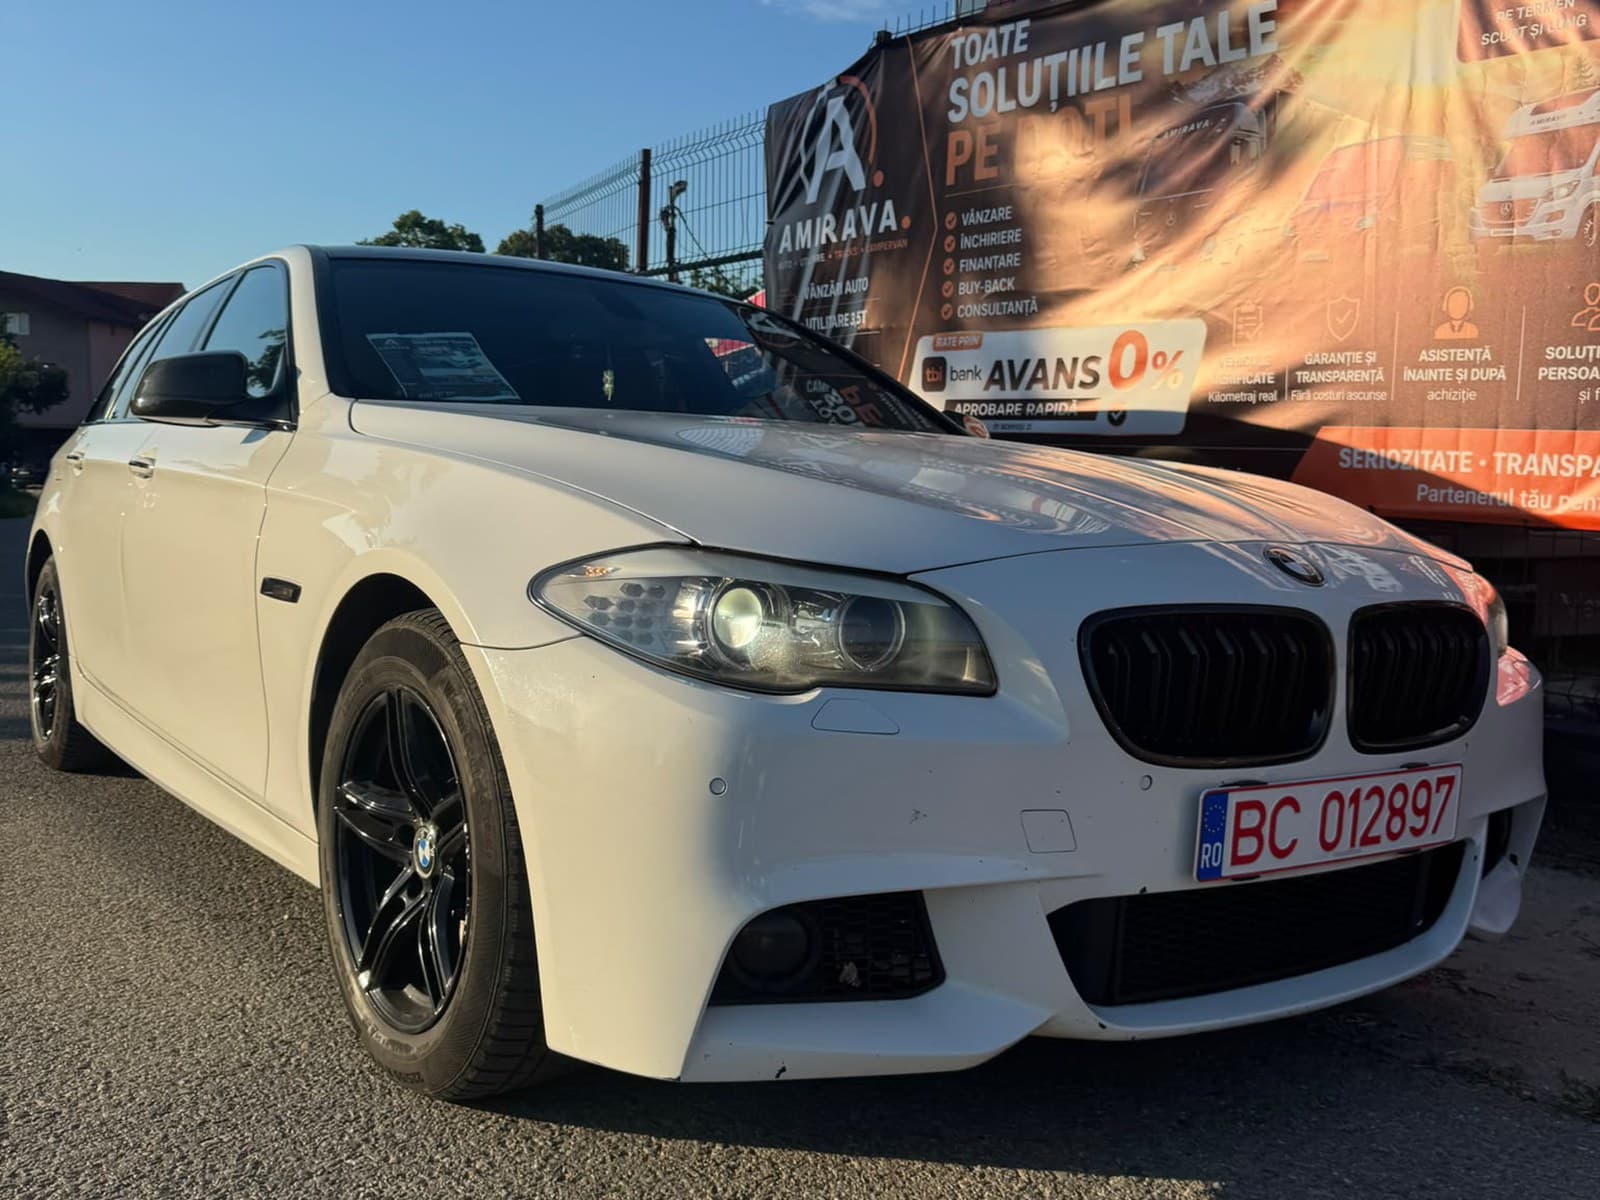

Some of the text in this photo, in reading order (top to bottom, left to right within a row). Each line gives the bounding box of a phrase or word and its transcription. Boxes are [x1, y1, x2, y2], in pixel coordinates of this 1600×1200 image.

[950, 18, 1031, 69] TOATE
[948, 0, 1278, 122] SOLUȚIILE TALE
[945, 122, 1000, 187] PE
[962, 206, 1012, 226] VÂNZARE
[960, 228, 1022, 250] ÎNCHIRIERE
[960, 253, 1021, 272] FINANȚARE
[845, 277, 868, 294] AUTO
[958, 277, 1015, 295] BUY-BACK
[957, 296, 1038, 318] CONSULTANȚĂ
[1305, 352, 1376, 367] GARANȚIE ȘI
[1419, 346, 1492, 364] ASISTENȚĂ
[950, 365, 982, 381] bank
[984, 356, 1102, 391] AVANS
[1296, 367, 1384, 384] TRANSPARENȚĂ
[1403, 365, 1507, 383] ÎNAINTE ȘI DUPĂ
[1538, 366, 1600, 381] PERSOA
[1208, 391, 1278, 404] Kilometraj real
[1313, 391, 1345, 401] costuri
[1346, 391, 1387, 401] ascunse
[1427, 388, 1477, 403] achiziție
[1578, 387, 1591, 404] și
[954, 402, 1022, 417] APROBARE
[1339, 447, 1473, 474] SERIOZITATE
[1416, 484, 1514, 506] Partenerul
[1520, 488, 1552, 509] tău
[1230, 775, 1456, 867] BC 012897
[1201, 842, 1223, 869] RO
